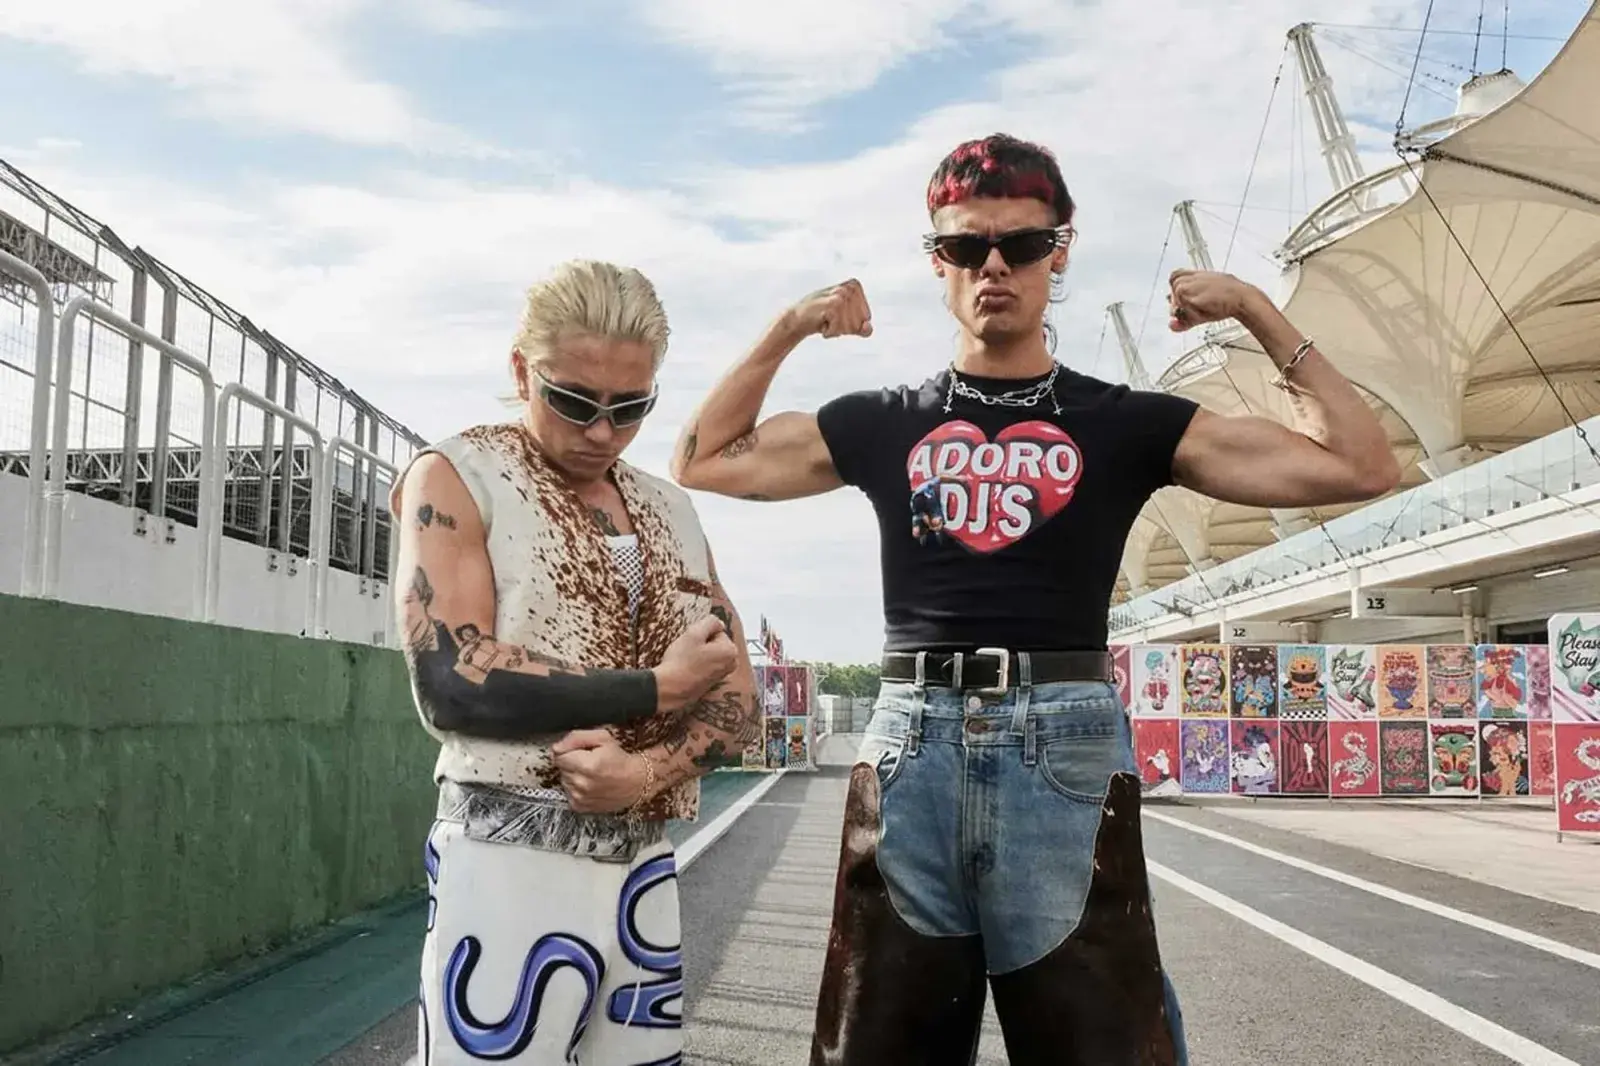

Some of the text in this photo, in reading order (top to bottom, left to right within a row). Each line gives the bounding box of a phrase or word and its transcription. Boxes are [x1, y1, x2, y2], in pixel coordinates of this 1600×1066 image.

[909, 441, 1078, 482] ADORO
[940, 482, 1033, 537] DJ'S
[1366, 597, 1385, 610] 13
[1233, 627, 1246, 638] 12
[1563, 650, 1598, 672] Stay
